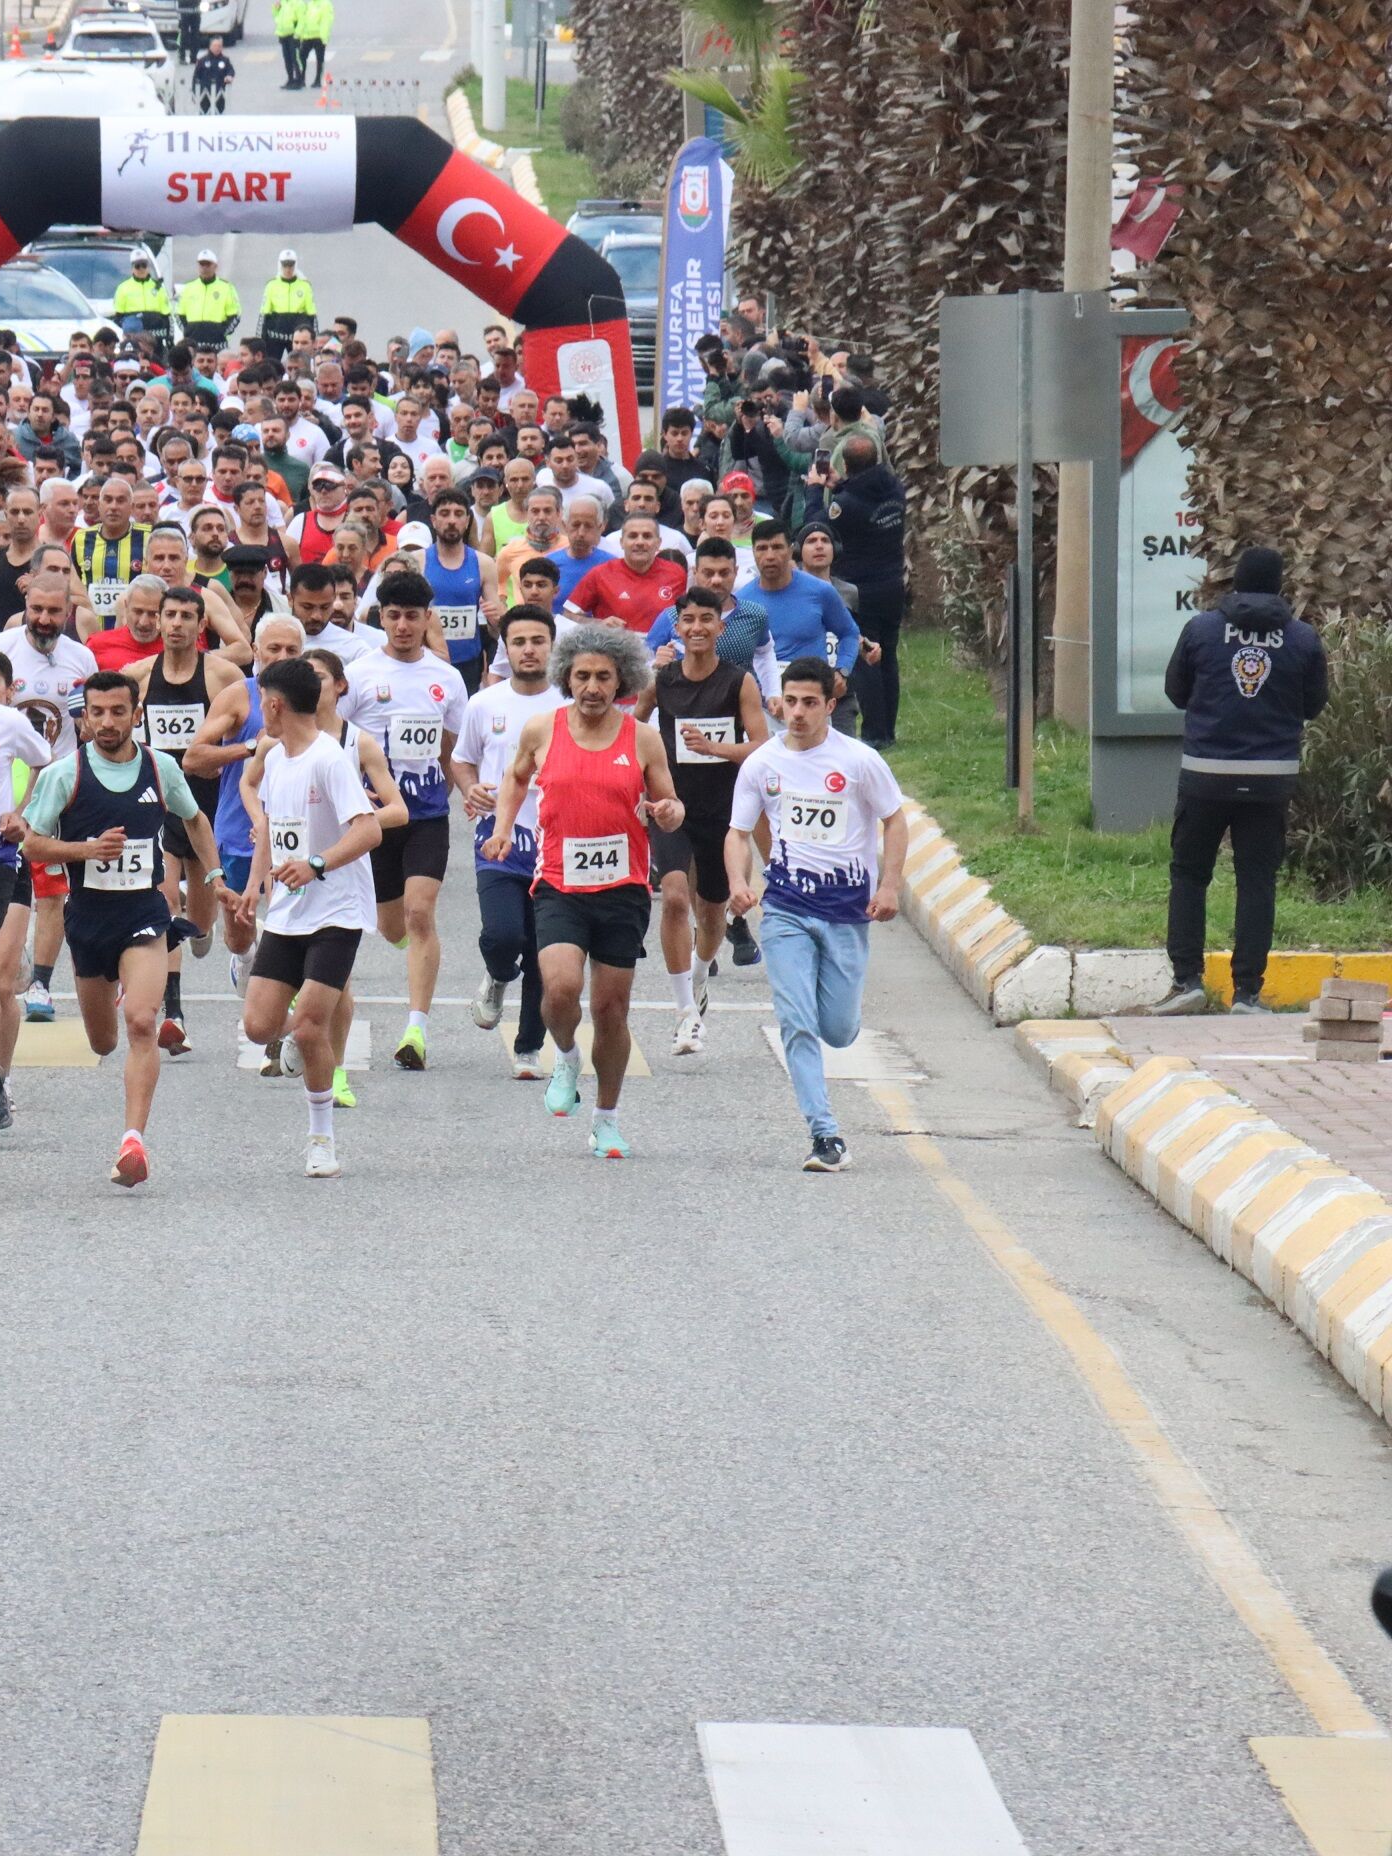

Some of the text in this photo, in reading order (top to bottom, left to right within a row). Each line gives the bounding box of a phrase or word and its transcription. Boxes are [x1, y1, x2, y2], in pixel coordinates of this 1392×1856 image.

[164, 130, 189, 153] 11
[166, 171, 292, 203] START
[440, 615, 467, 628] 351
[156, 717, 196, 735] 362
[399, 727, 437, 745] 400
[791, 805, 836, 828] 370
[573, 849, 619, 870] 244
